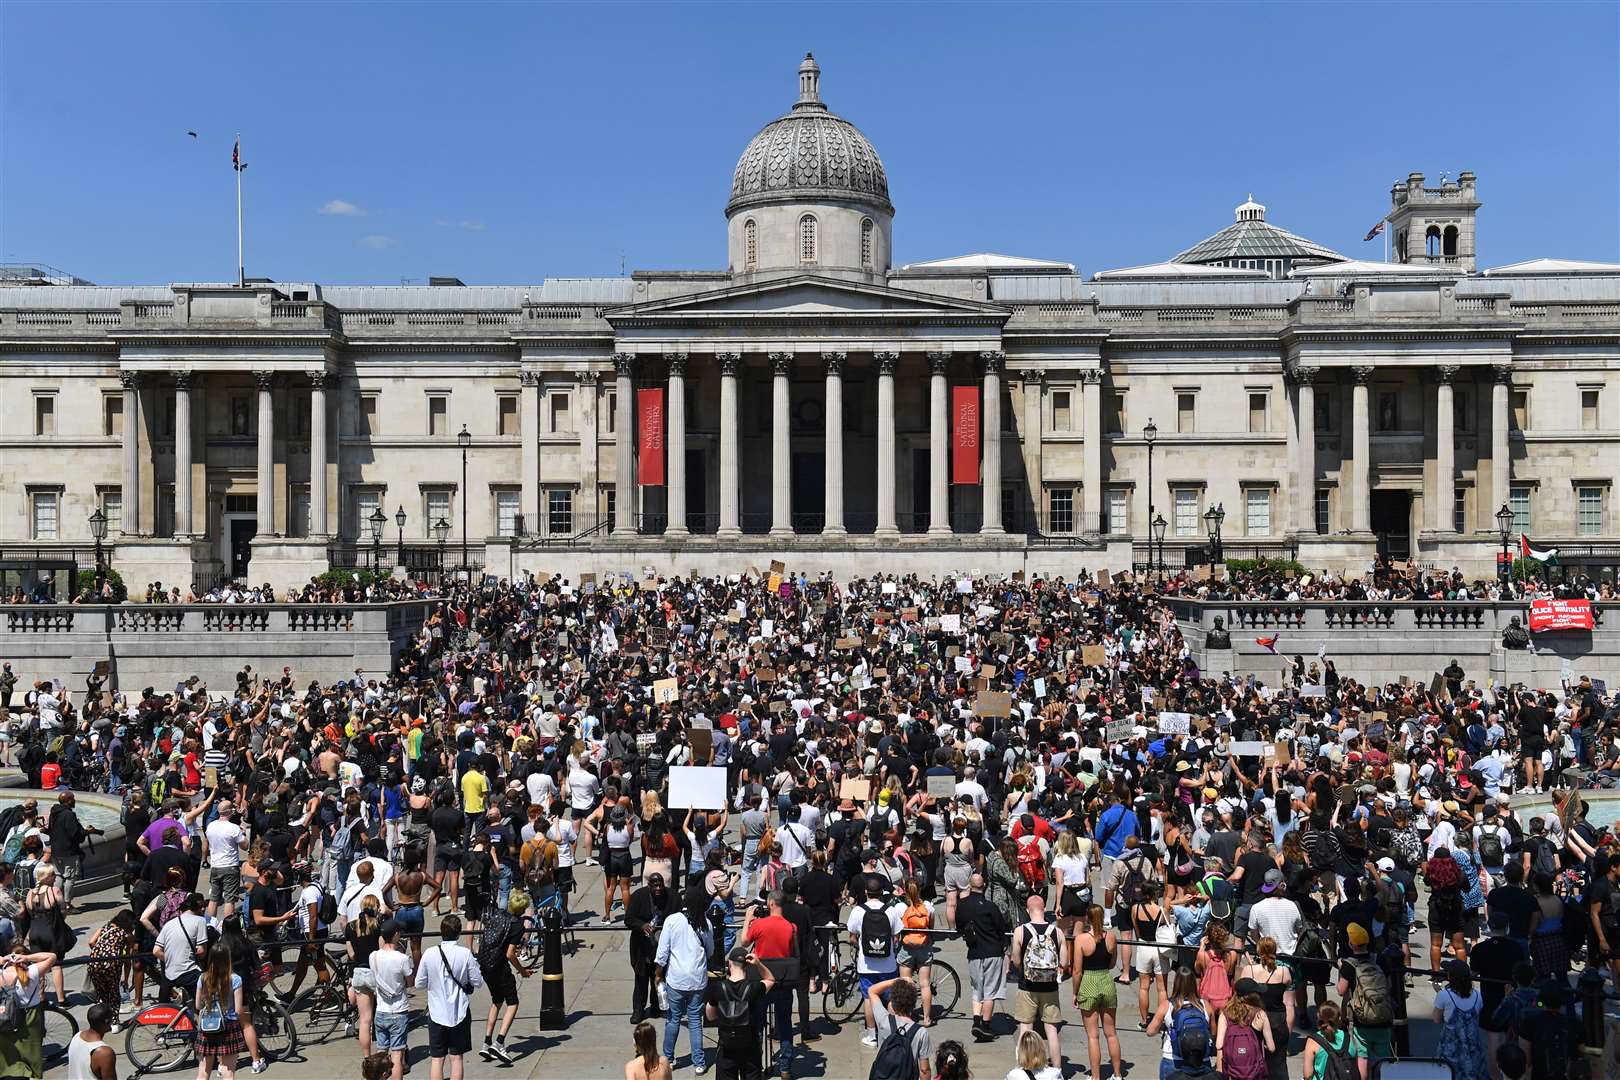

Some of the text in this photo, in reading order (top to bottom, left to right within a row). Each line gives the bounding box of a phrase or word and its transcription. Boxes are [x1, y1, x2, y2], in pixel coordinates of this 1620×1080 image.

[967, 403, 976, 448] GALLERY
[1531, 607, 1553, 615] OLICE
[1172, 720, 1186, 729] NOT
